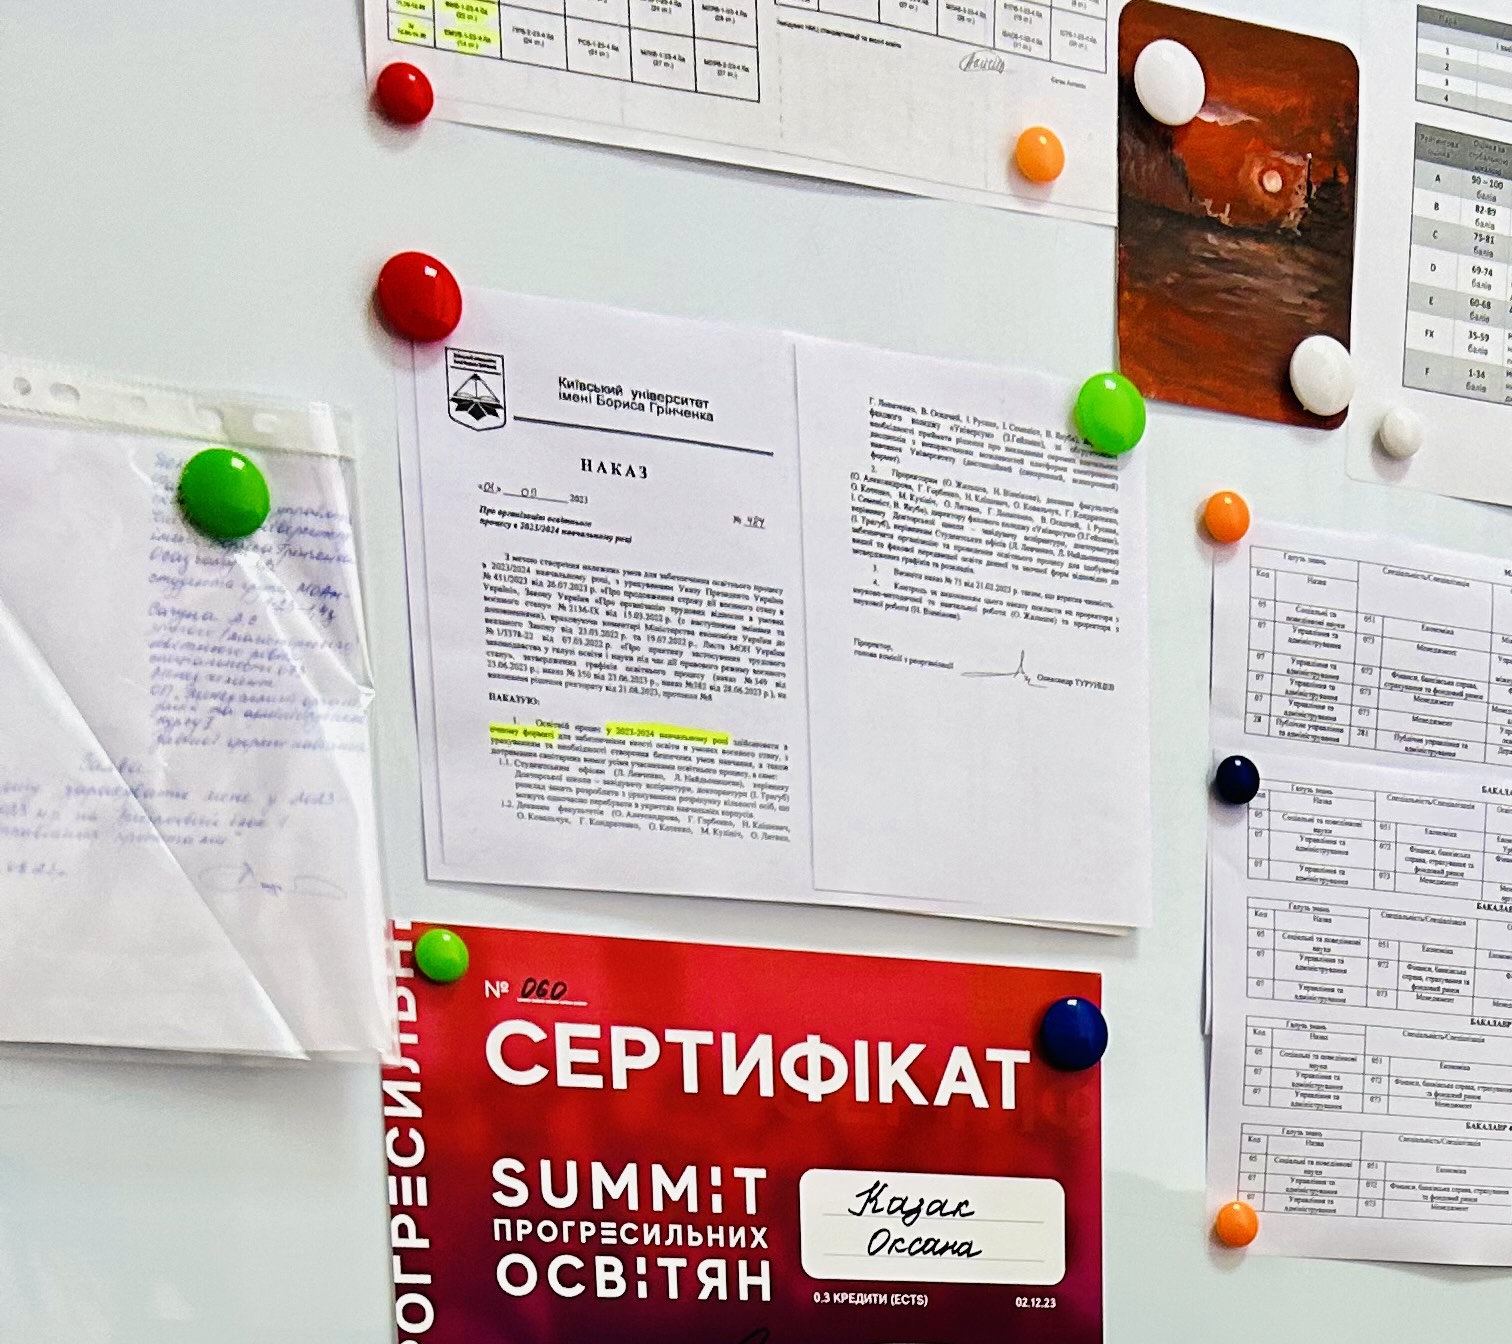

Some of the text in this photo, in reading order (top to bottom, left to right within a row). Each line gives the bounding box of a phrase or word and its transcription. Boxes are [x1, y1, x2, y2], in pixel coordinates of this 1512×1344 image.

[559, 376, 709, 409] Київський університет
[559, 391, 713, 422] імені Бориса Грінченка
[581, 458, 648, 479] НАКАЗ
[484, 980, 509, 998] №
[1470, 1018, 1510, 1031] БАКАЛАВР
[485, 1018, 1031, 1111] СЕРТИФІКАТ
[848, 1180, 975, 1227] Казак
[493, 1218, 768, 1249] ПРОГРЕСИЛЬНИХ
[867, 1228, 983, 1258] Оксана
[497, 1253, 771, 1302] ОСВІТЯН
[834, 1293, 887, 1306] КРЕДИТИ
[891, 1294, 928, 1307] (ECTS)
[1015, 1296, 1056, 1308] 02.12.23
